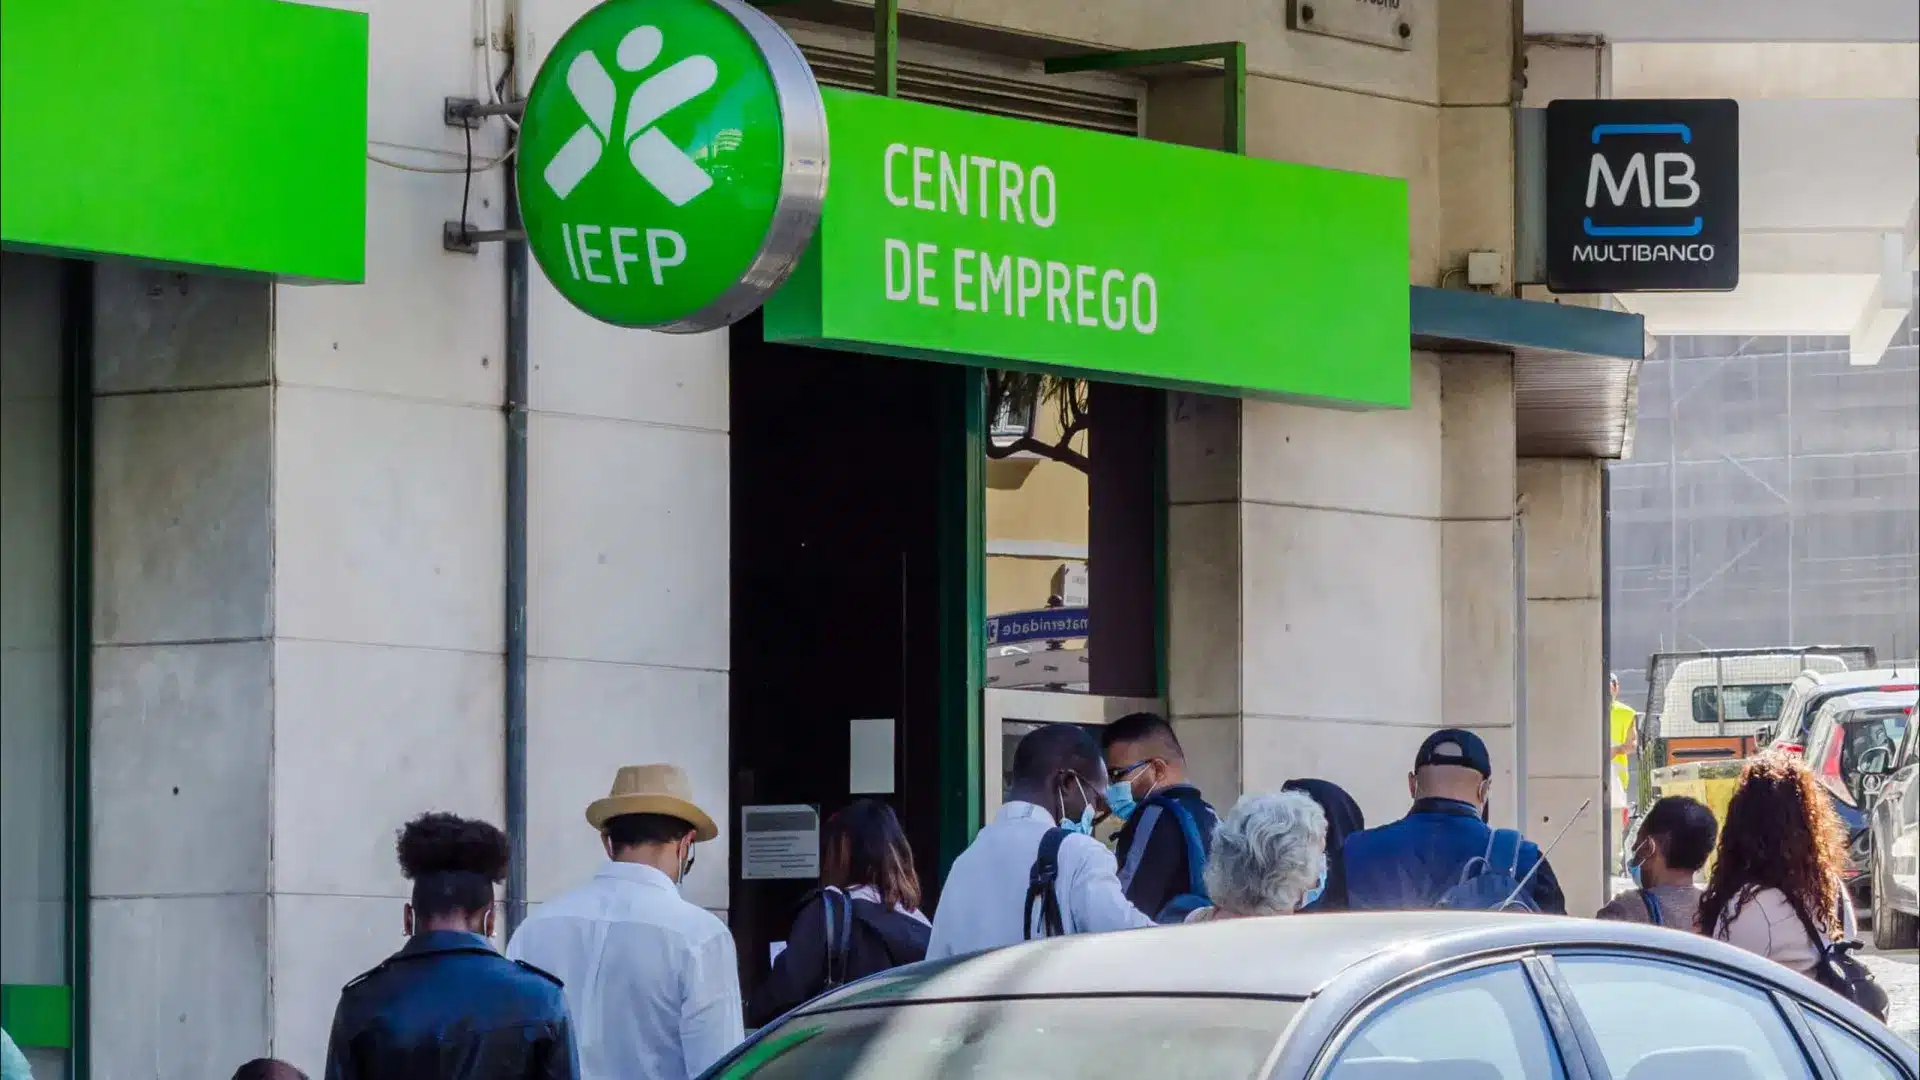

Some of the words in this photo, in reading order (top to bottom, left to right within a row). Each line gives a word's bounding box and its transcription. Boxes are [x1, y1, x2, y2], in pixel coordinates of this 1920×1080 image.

[884, 143, 1056, 228] CENTRO
[1585, 152, 1700, 208] MB
[562, 223, 687, 286] IEFP
[1572, 244, 1715, 262] MULTIBANCO
[884, 239, 939, 306] DE
[954, 248, 1158, 335] EMPREGO
